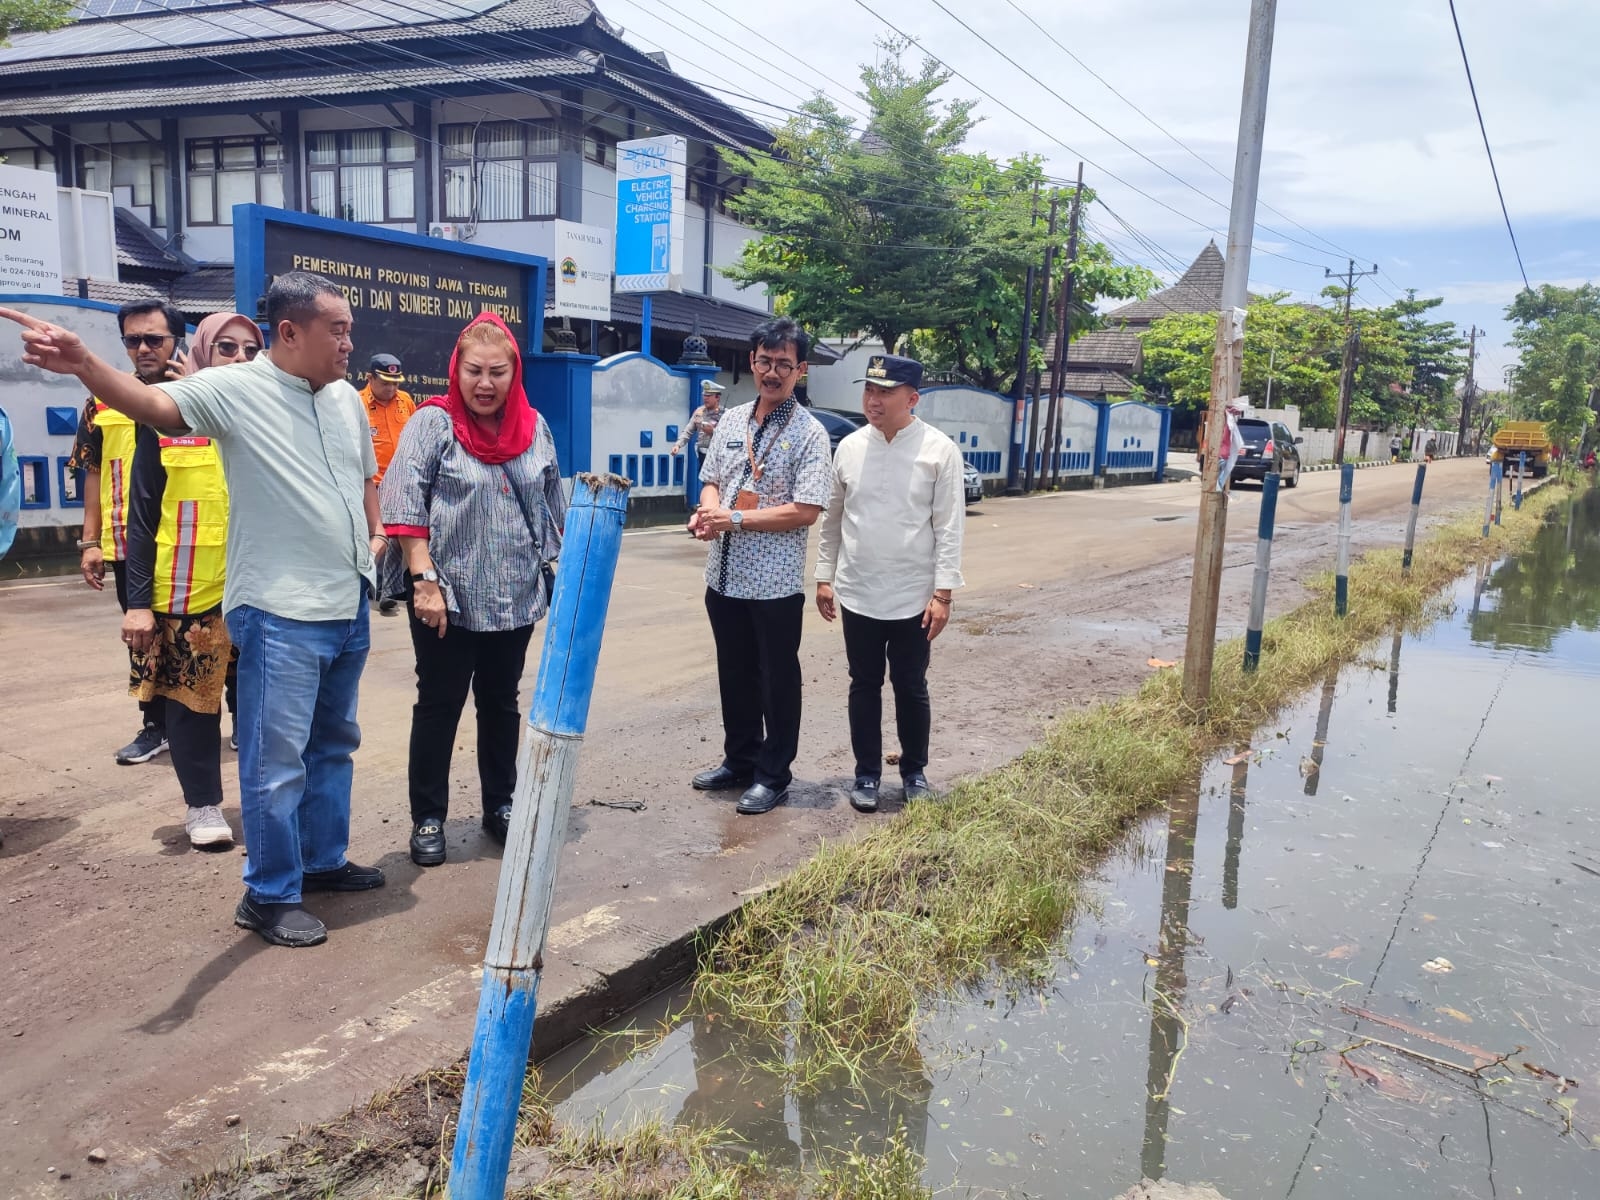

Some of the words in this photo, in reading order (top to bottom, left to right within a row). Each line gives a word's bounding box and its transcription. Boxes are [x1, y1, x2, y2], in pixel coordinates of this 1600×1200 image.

[631, 179, 670, 192] ELECTRIC
[635, 190, 670, 202] VEHICLE
[2, 206, 53, 221] MINERAL
[625, 201, 669, 214] CHARGING
[634, 212, 669, 224] STATION
[4, 254, 44, 266] Semarang
[293, 254, 372, 280] PEMERINTAH
[378, 268, 430, 288] PROVINSI
[435, 276, 464, 293] JAWA
[468, 281, 507, 299] TENGAH
[370, 288, 392, 311] DAN
[399, 292, 441, 316] SUMBER
[447, 298, 474, 319] DAYA
